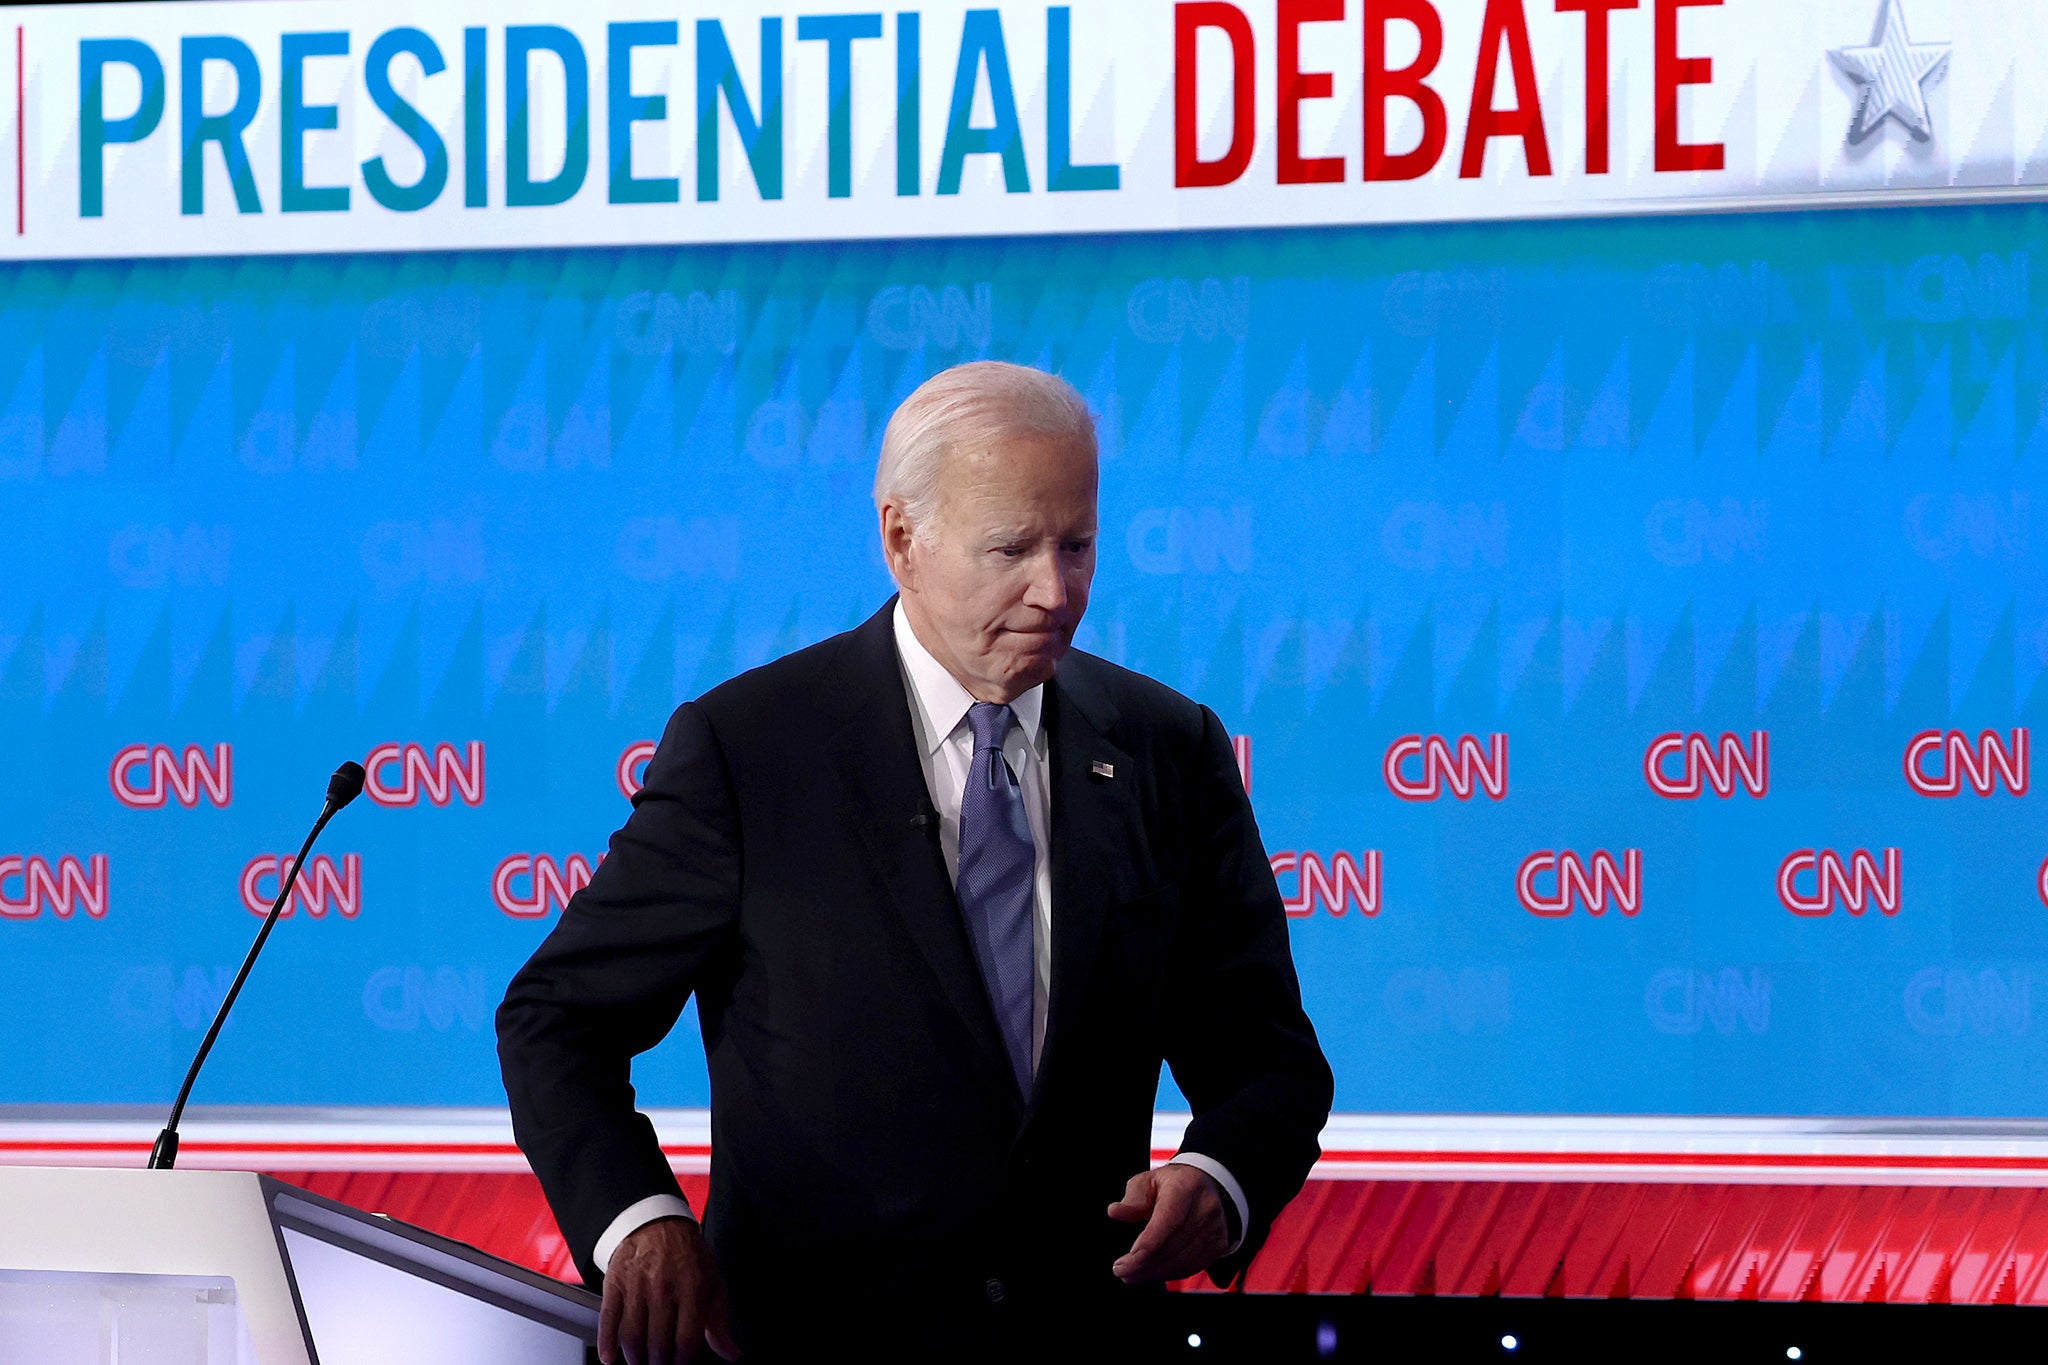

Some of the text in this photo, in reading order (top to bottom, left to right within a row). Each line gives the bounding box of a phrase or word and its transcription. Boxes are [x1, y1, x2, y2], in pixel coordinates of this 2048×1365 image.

[79, 0, 1725, 218] PRESIDENTIAL DEBATE
[867, 282, 993, 350] CNN
[1126, 275, 1250, 342] CNN
[1126, 501, 1255, 574] CNN
[110, 744, 231, 809] CNN
[363, 742, 484, 808] CNN
[1384, 733, 1508, 801] CNN
[1644, 731, 1769, 799] CNN
[1904, 728, 2030, 797] CNN
[240, 854, 361, 919] CNN
[1516, 849, 1641, 918] CNN
[1776, 848, 1901, 917] CNN
[362, 964, 486, 1032] CNN
[1643, 965, 1772, 1036] CNN
[1902, 965, 2032, 1037] CNN
